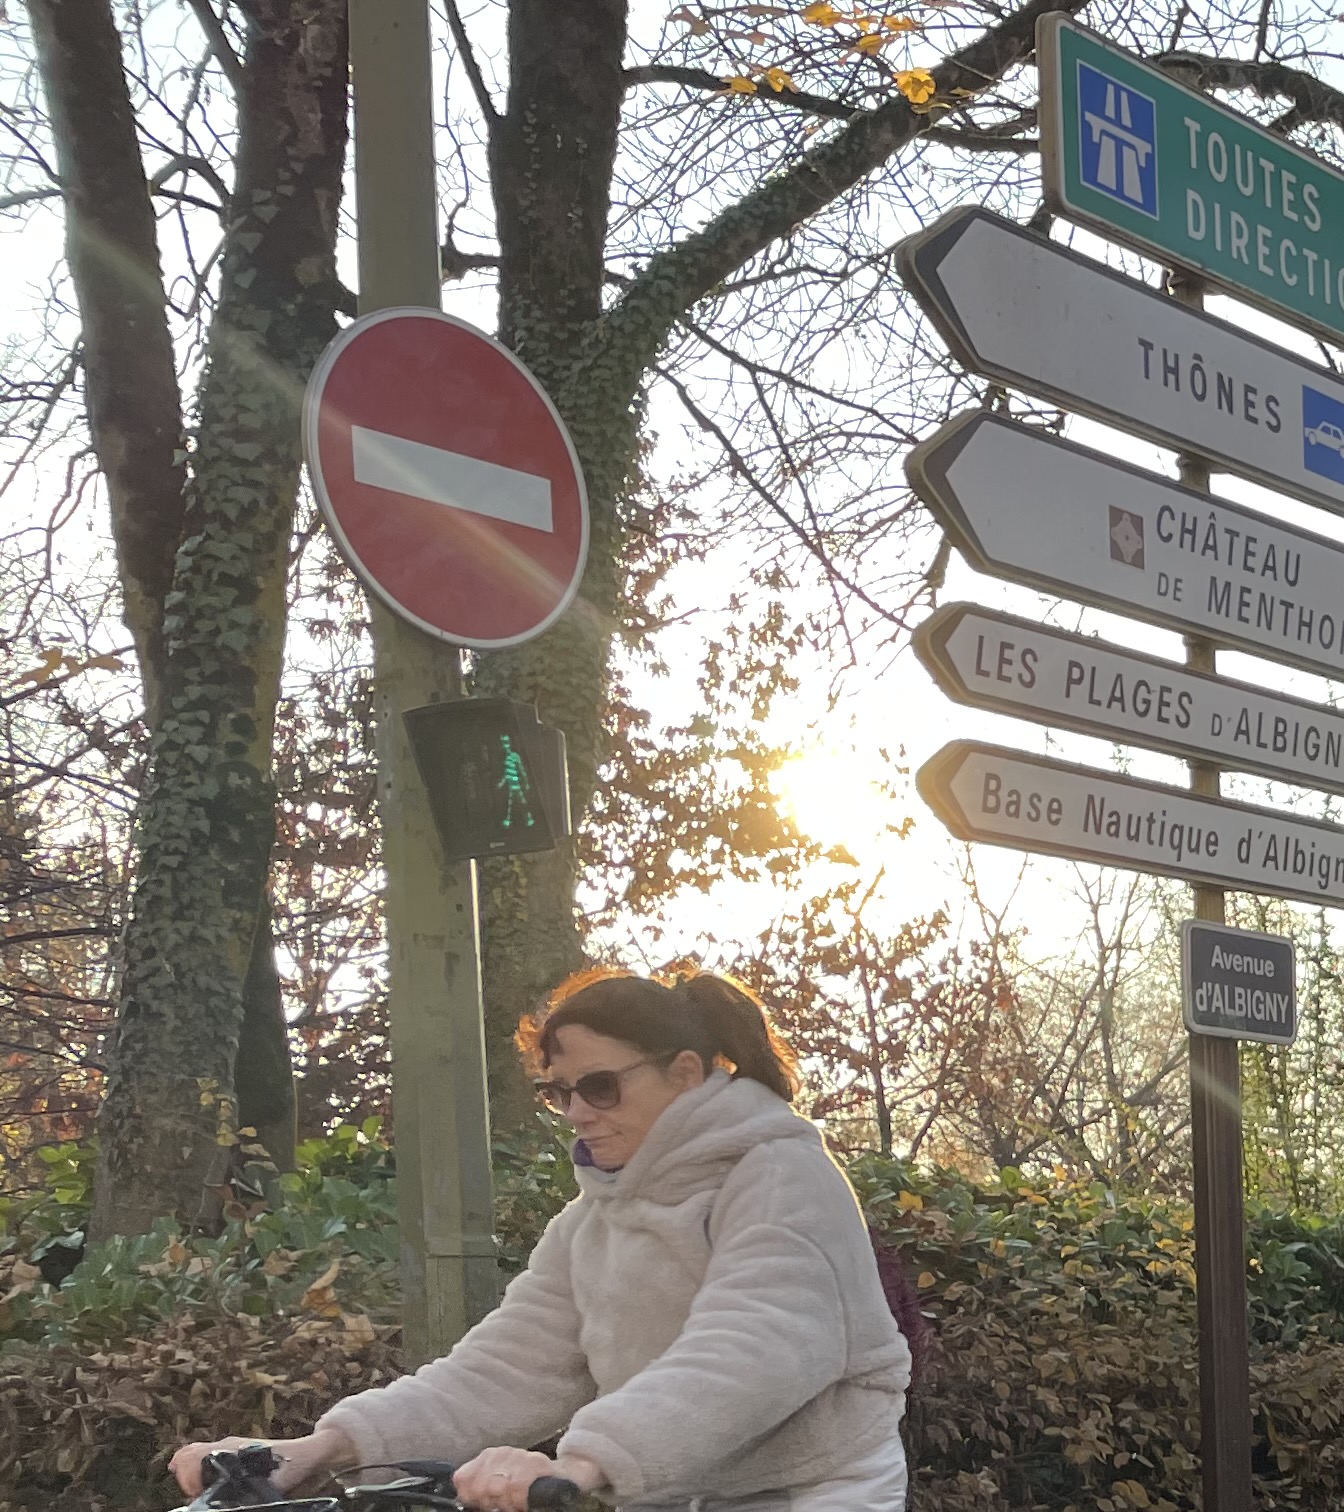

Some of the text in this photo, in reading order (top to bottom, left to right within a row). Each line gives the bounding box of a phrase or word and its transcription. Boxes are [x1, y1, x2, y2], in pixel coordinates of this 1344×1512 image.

[1183, 115, 1322, 232] TOUTES
[1138, 336, 1282, 434] THÔNES
[1156, 504, 1301, 587] CHÂTEAU
[1157, 571, 1184, 602] DE
[974, 635, 1038, 689] LES
[1064, 659, 1193, 728] PLAGES
[981, 772, 1062, 827] Base
[1082, 794, 1219, 862] Nautique
[1195, 982, 1289, 1024] d'ALBIGNY
[1210, 944, 1275, 978] Avenue
